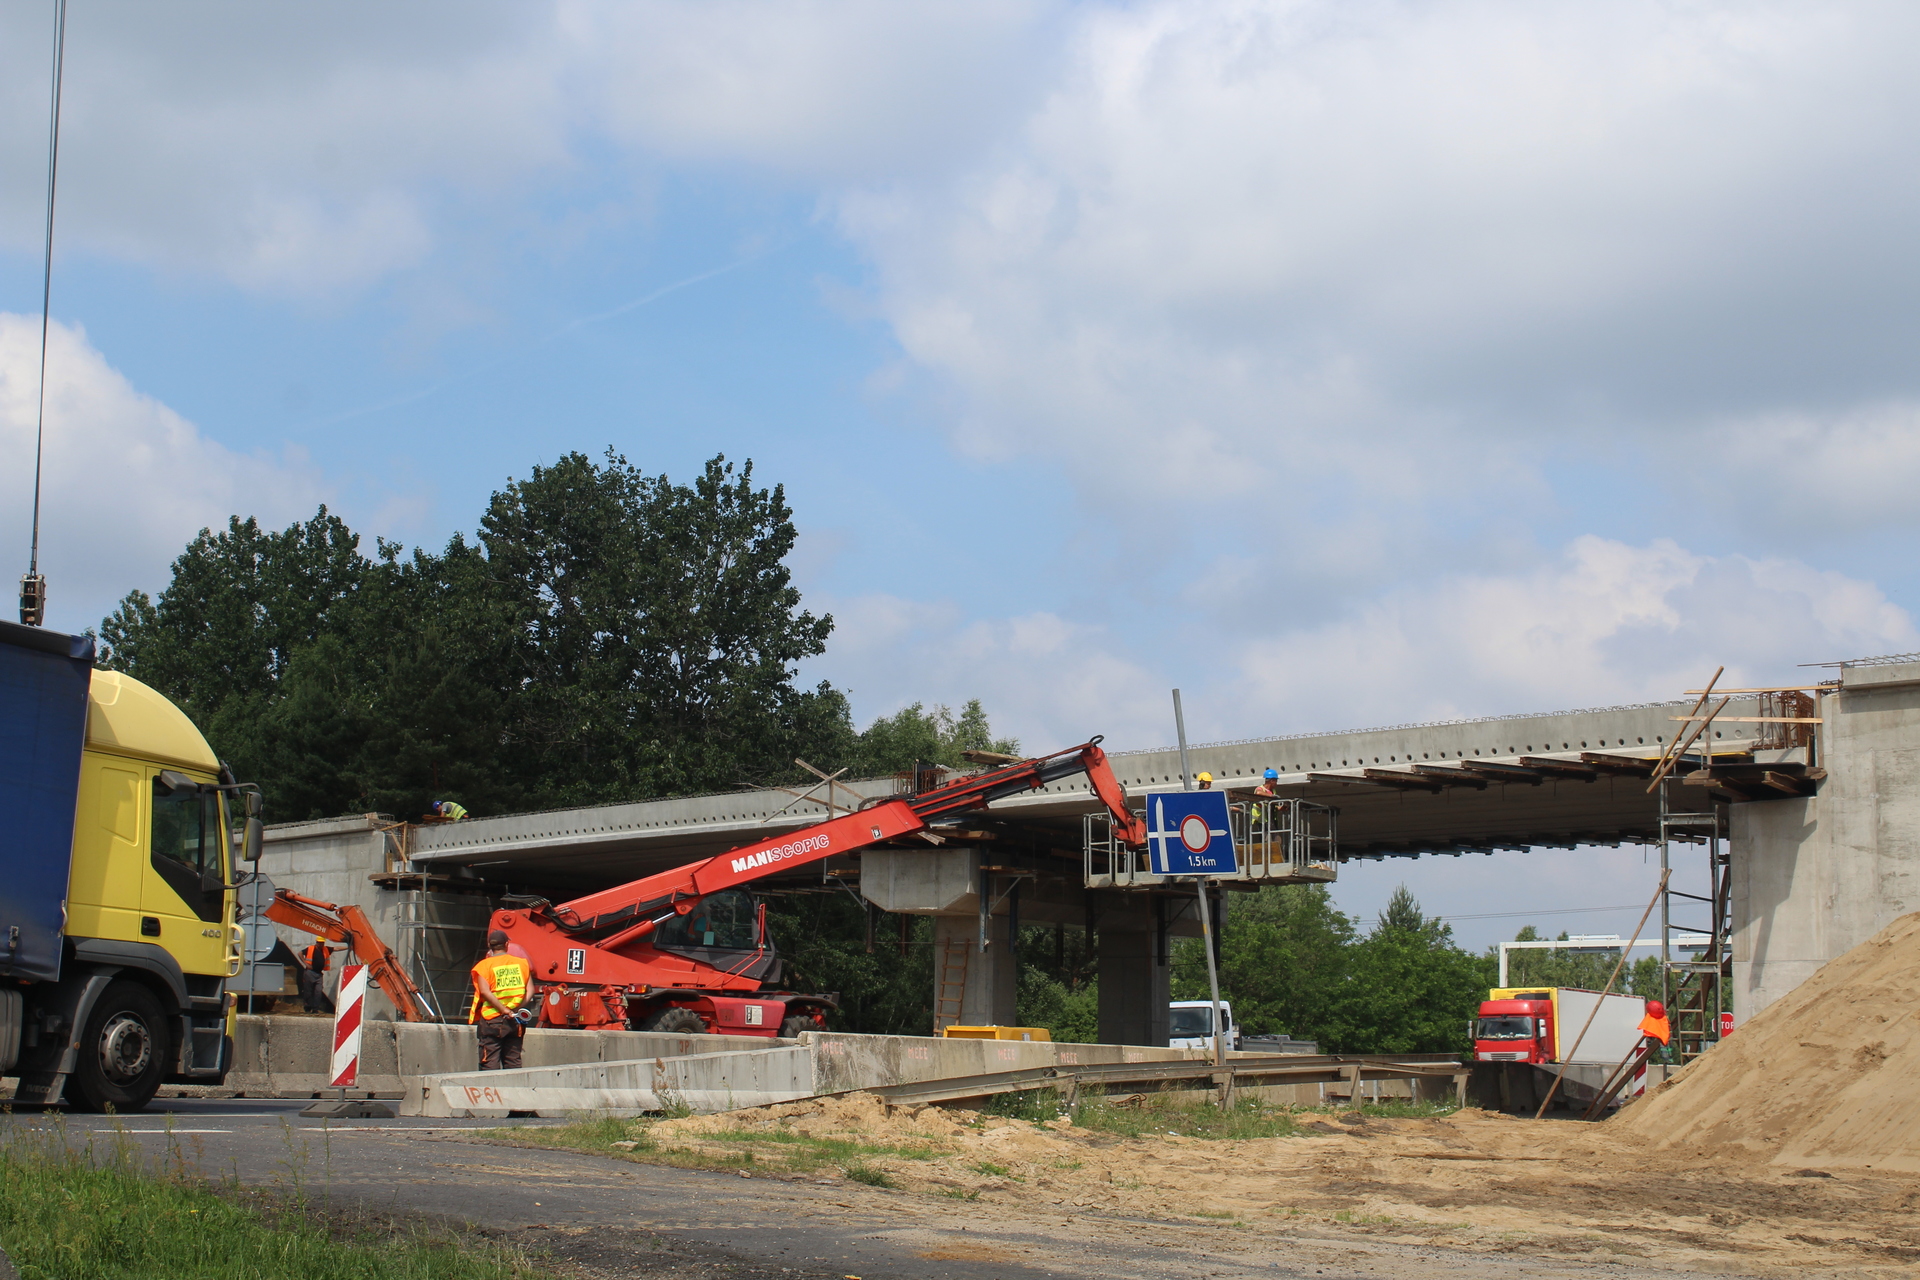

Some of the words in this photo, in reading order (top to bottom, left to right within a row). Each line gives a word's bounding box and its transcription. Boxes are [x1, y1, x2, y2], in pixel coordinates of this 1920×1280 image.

[731, 834, 830, 873] MANISCOPIC
[1202, 856, 1216, 867] km
[301, 918, 327, 933] HITACHI
[201, 928, 222, 939] 400
[496, 976, 523, 988] RUCHEM
[25, 1083, 52, 1094] IVECO
